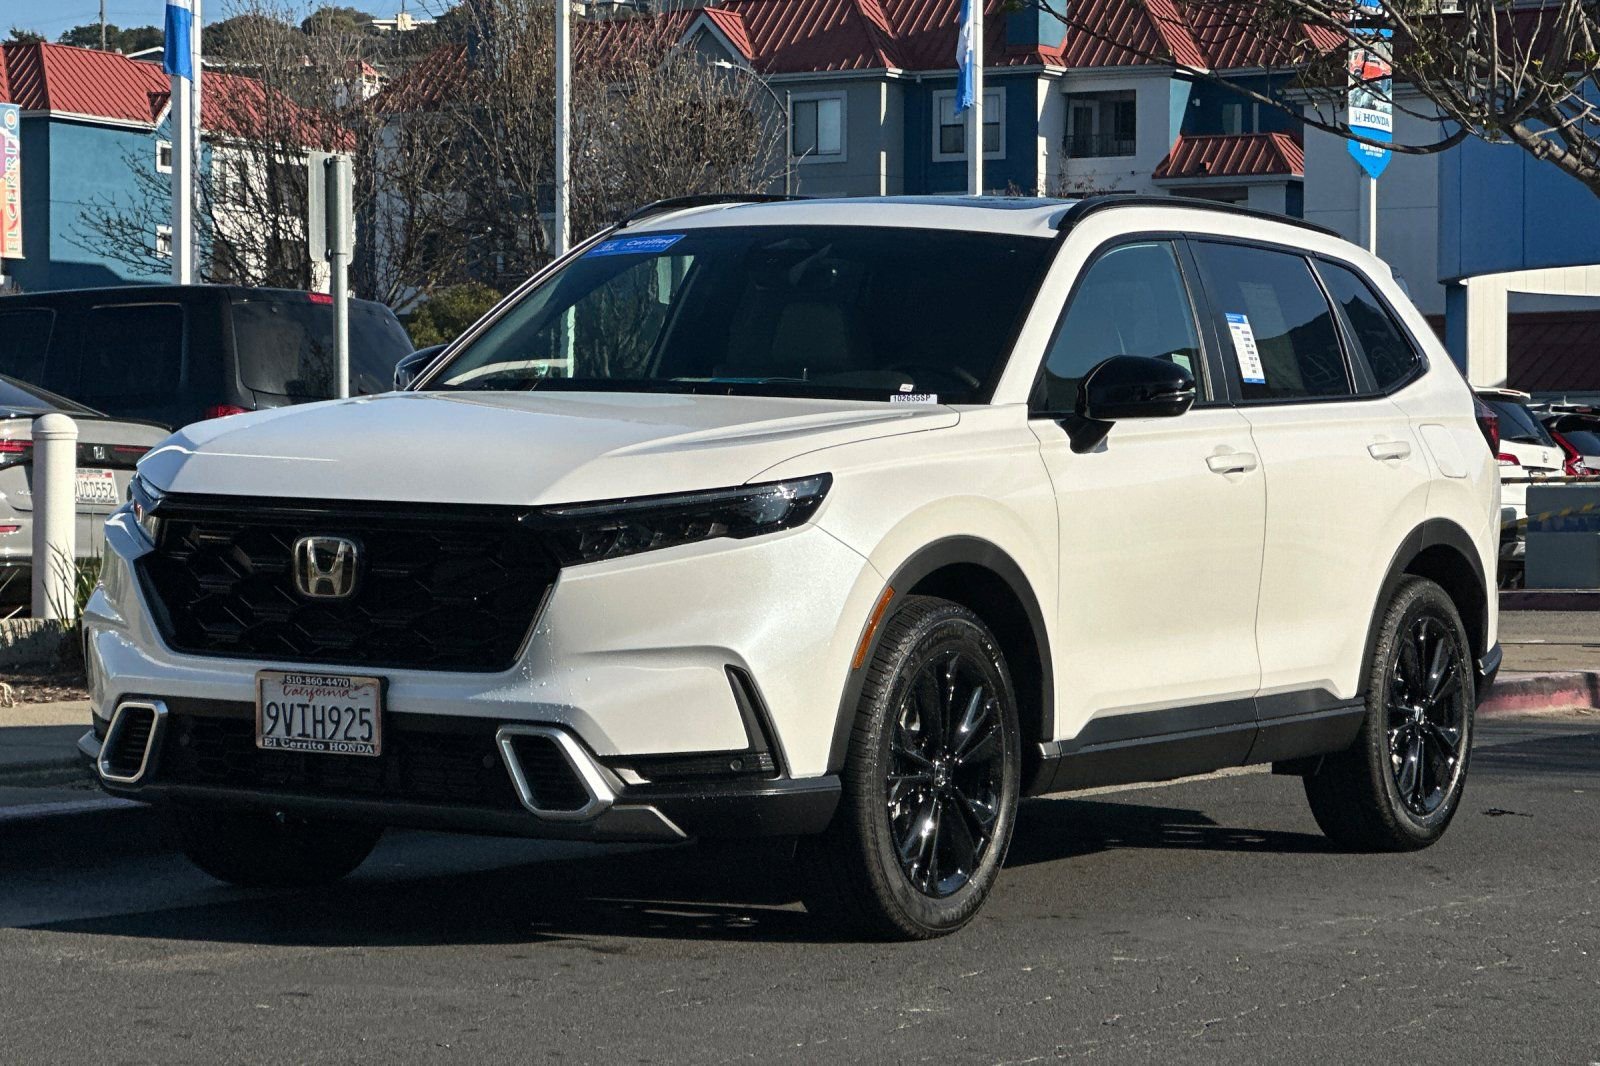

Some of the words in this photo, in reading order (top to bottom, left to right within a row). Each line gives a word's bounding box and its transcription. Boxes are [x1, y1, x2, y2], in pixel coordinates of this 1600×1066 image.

[1363, 113, 1390, 127] HONDA
[4, 108, 18, 221] CERRITO
[6, 228, 18, 251] EL
[286, 675, 350, 687] 510-860-4470
[283, 685, 358, 702] California
[266, 702, 373, 742] 9VIH925
[264, 738, 277, 747] El
[281, 739, 325, 750] Cerrito
[329, 742, 374, 754] HONDA
